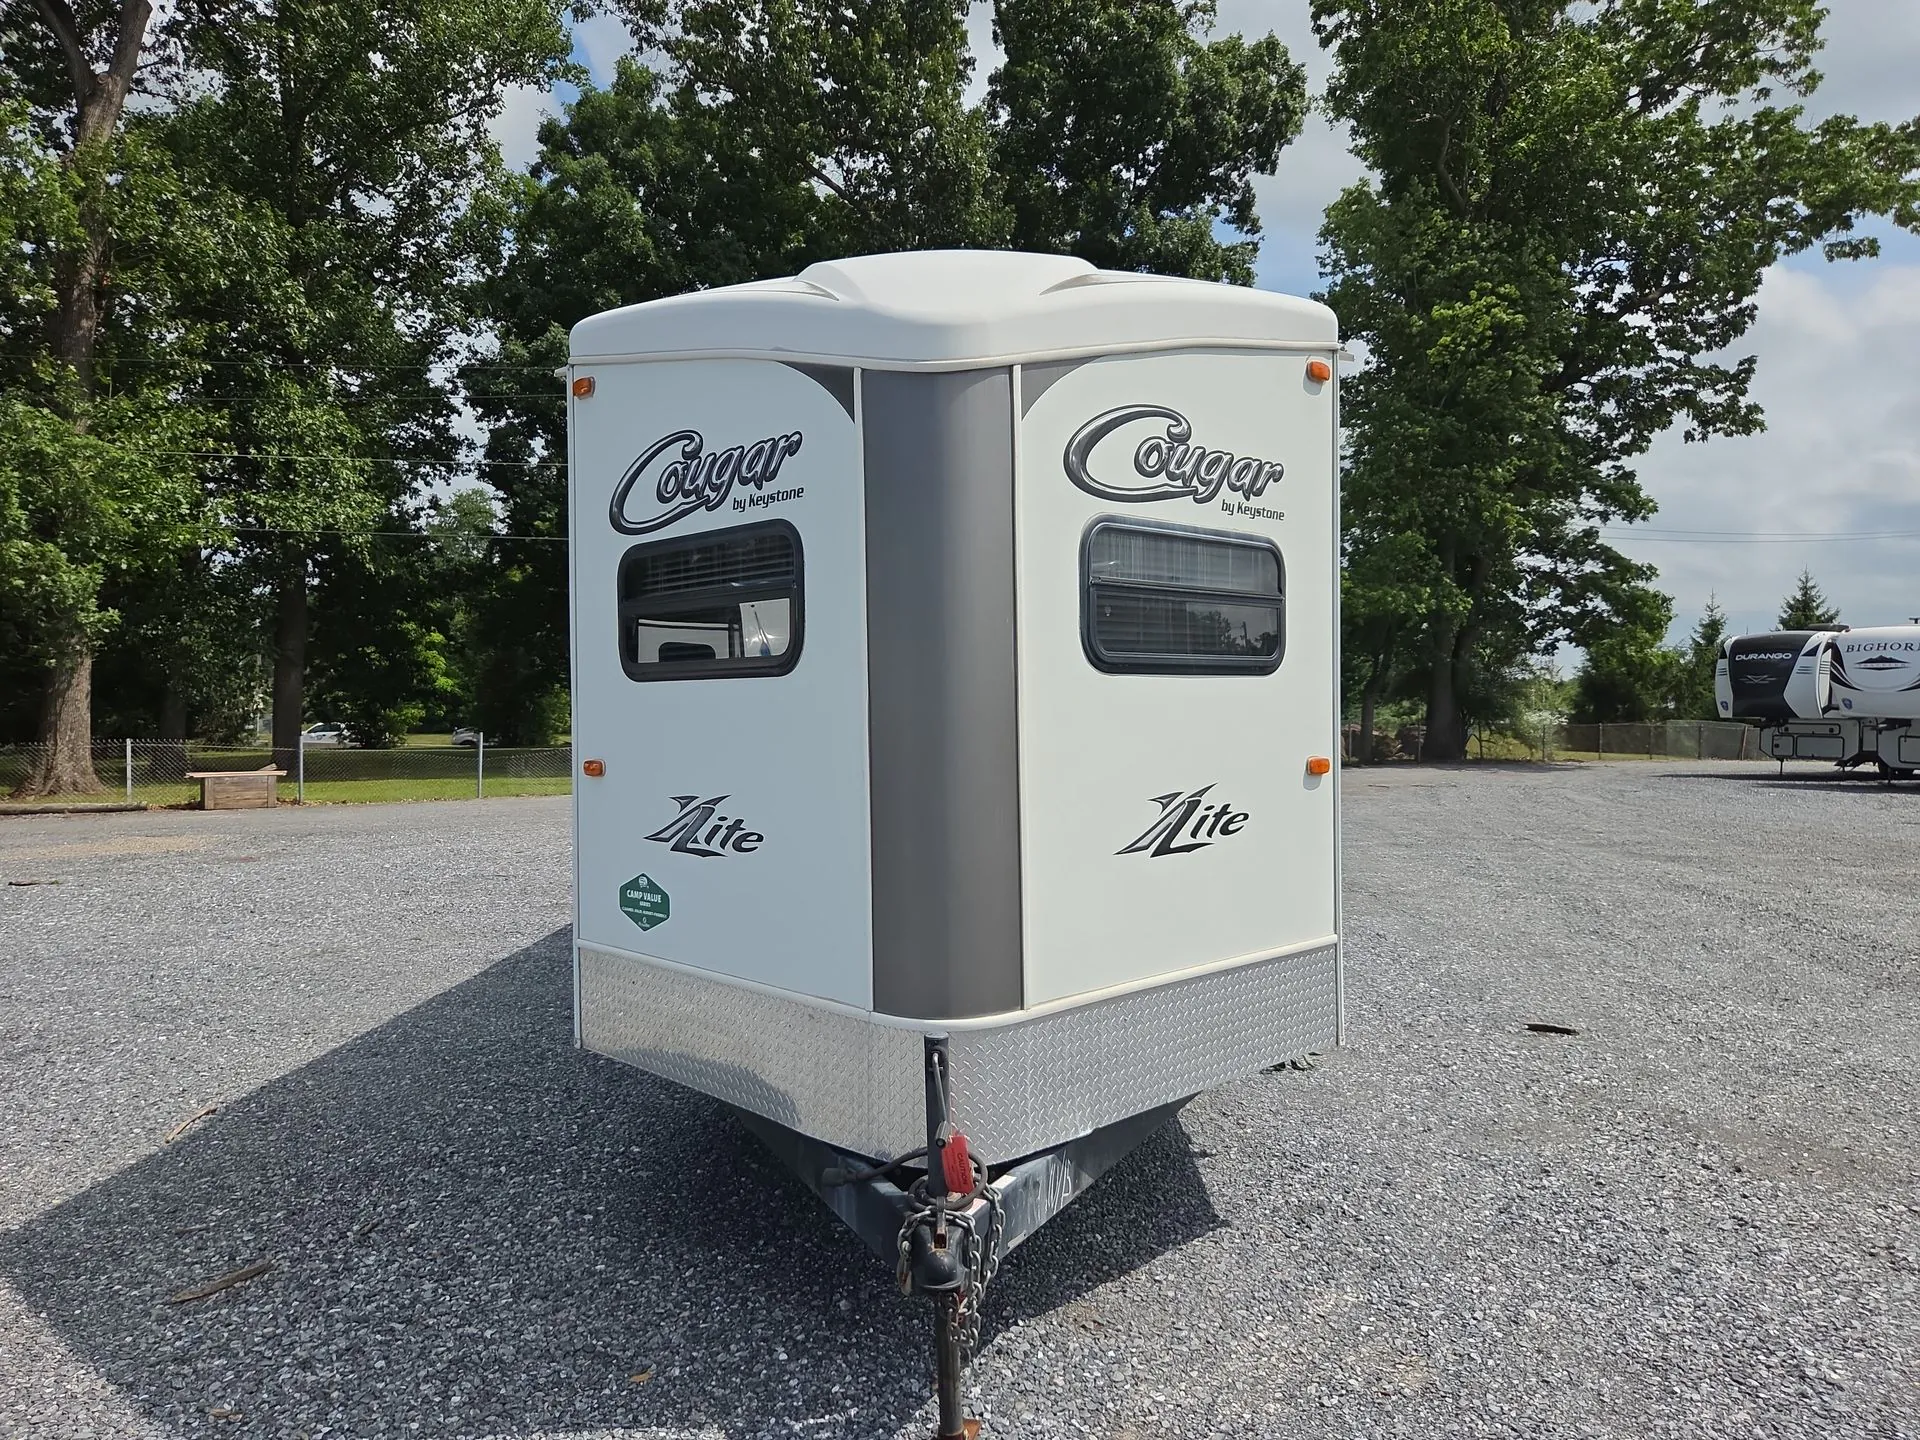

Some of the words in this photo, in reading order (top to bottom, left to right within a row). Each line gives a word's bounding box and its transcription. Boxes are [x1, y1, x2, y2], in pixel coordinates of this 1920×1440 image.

[1063, 403, 1285, 504] Cougar
[609, 429, 803, 536] Cougar
[732, 497, 747, 513] by
[748, 487, 804, 508] Keystone
[1221, 499, 1235, 516] by
[1236, 501, 1285, 521] Keystone
[1735, 652, 1793, 661] DURANGO
[626, 889, 643, 900] CAMP
[643, 892, 662, 903] VALUE
